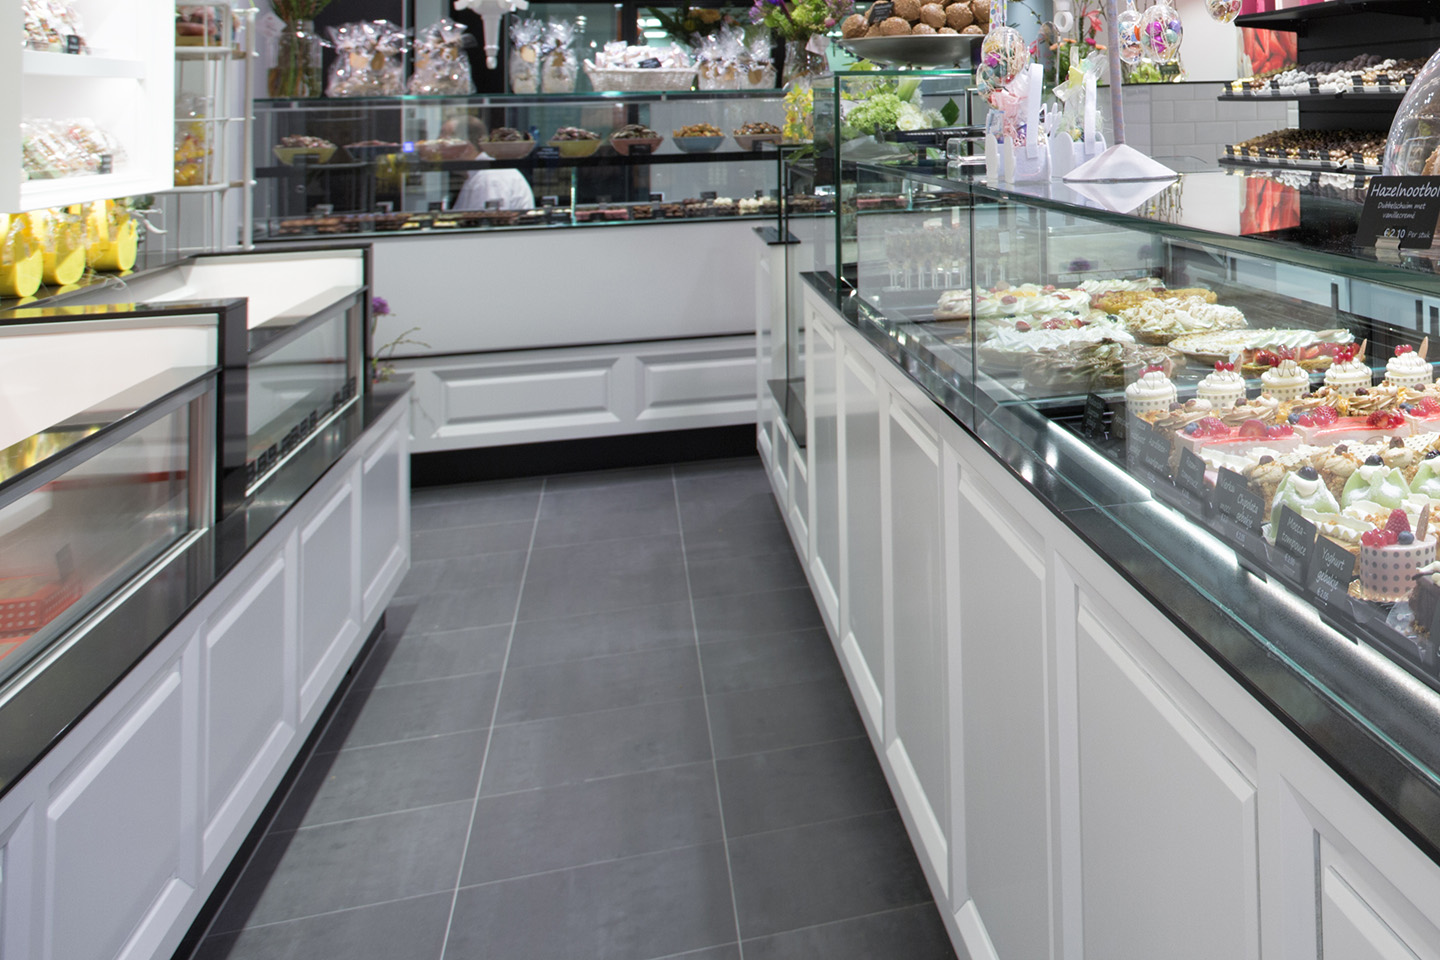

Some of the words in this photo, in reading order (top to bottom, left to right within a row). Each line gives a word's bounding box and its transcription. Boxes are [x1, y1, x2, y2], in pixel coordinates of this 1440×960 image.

[1377, 201, 1413, 210] Dubbelschuim
[1413, 202, 1426, 210] met
[1407, 231, 1418, 239] Per
[1418, 231, 1431, 239] stuk
[1322, 547, 1345, 571] Yoghurt
[1315, 569, 1339, 592] gebakje
